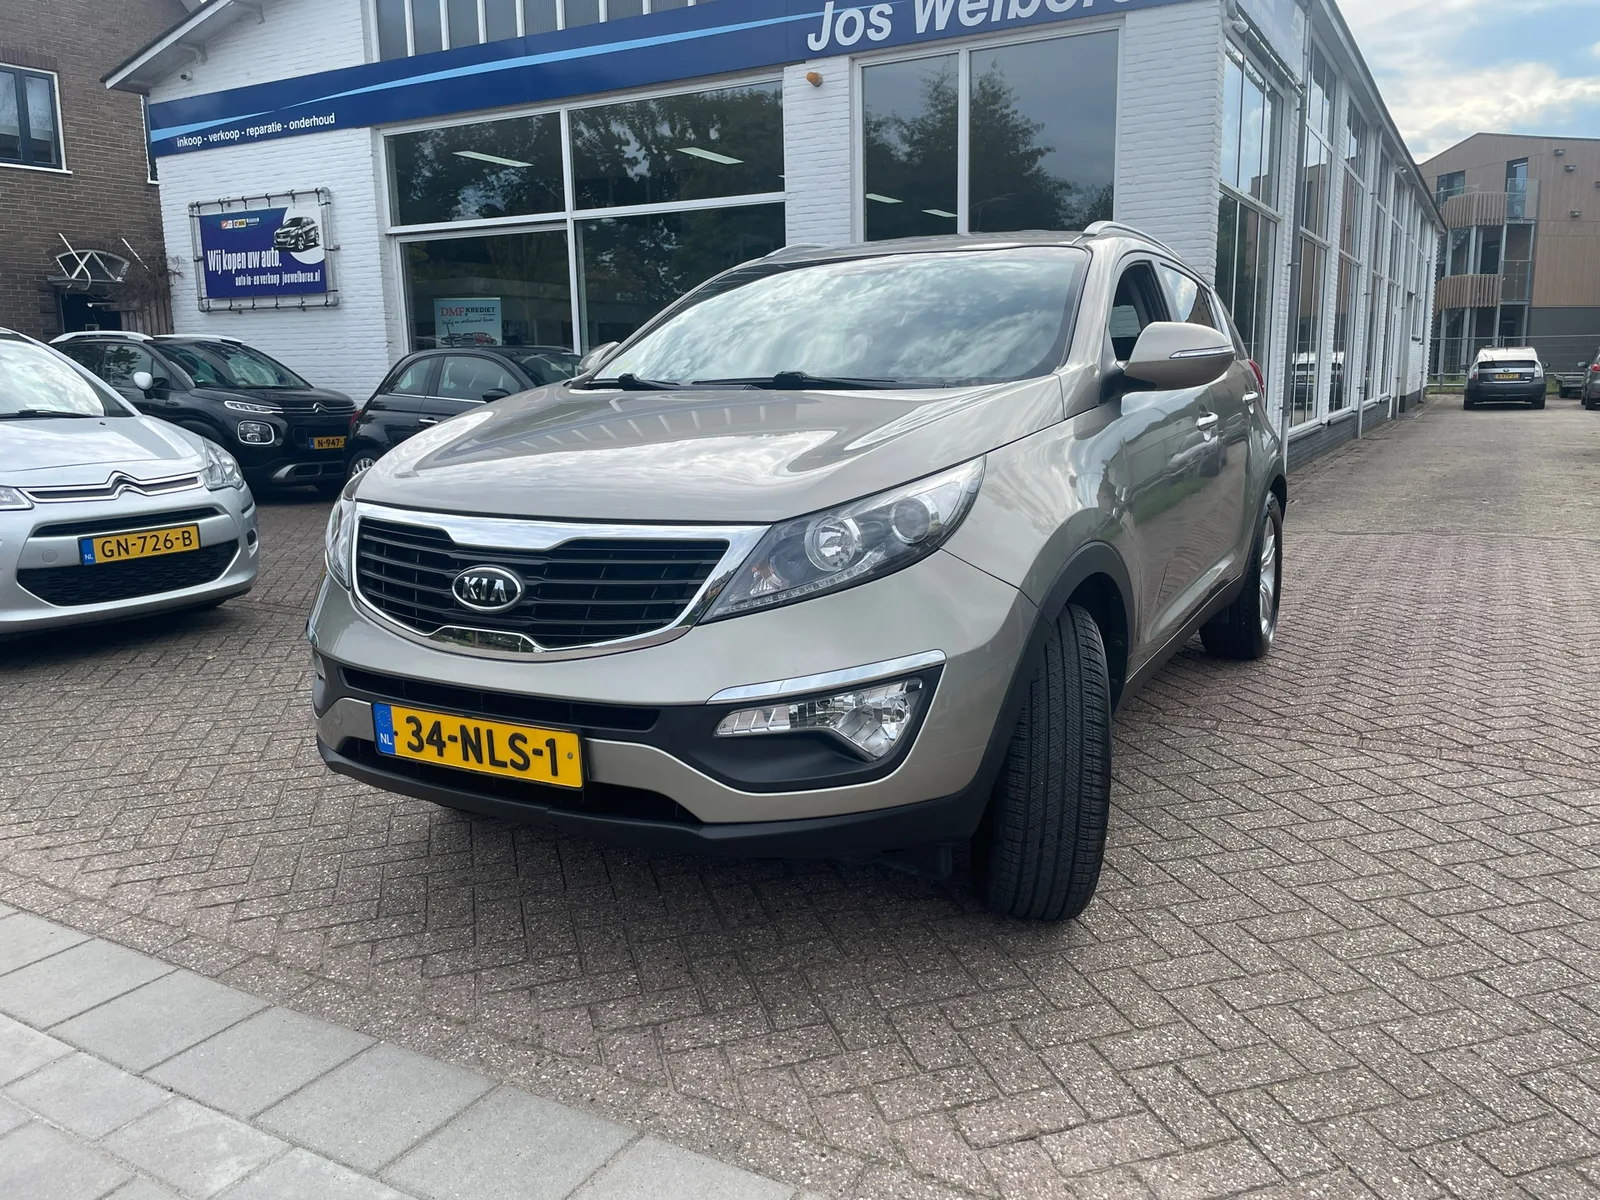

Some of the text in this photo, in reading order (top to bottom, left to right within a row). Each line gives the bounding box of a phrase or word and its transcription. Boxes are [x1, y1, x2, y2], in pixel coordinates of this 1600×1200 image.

[807, 1, 893, 51] Jos
[177, 135, 203, 147] inkoop
[208, 130, 240, 142] verkoop
[246, 122, 282, 138] reparatie
[289, 112, 335, 130] onderhoud
[207, 247, 282, 275] Wij kopen uw auto.
[260, 272, 280, 286] verkoop
[441, 306, 464, 316] DMF
[318, 438, 343, 448] N-947-
[101, 530, 192, 558] GN-726-B
[380, 716, 558, 777] NL 34-NLS-1
